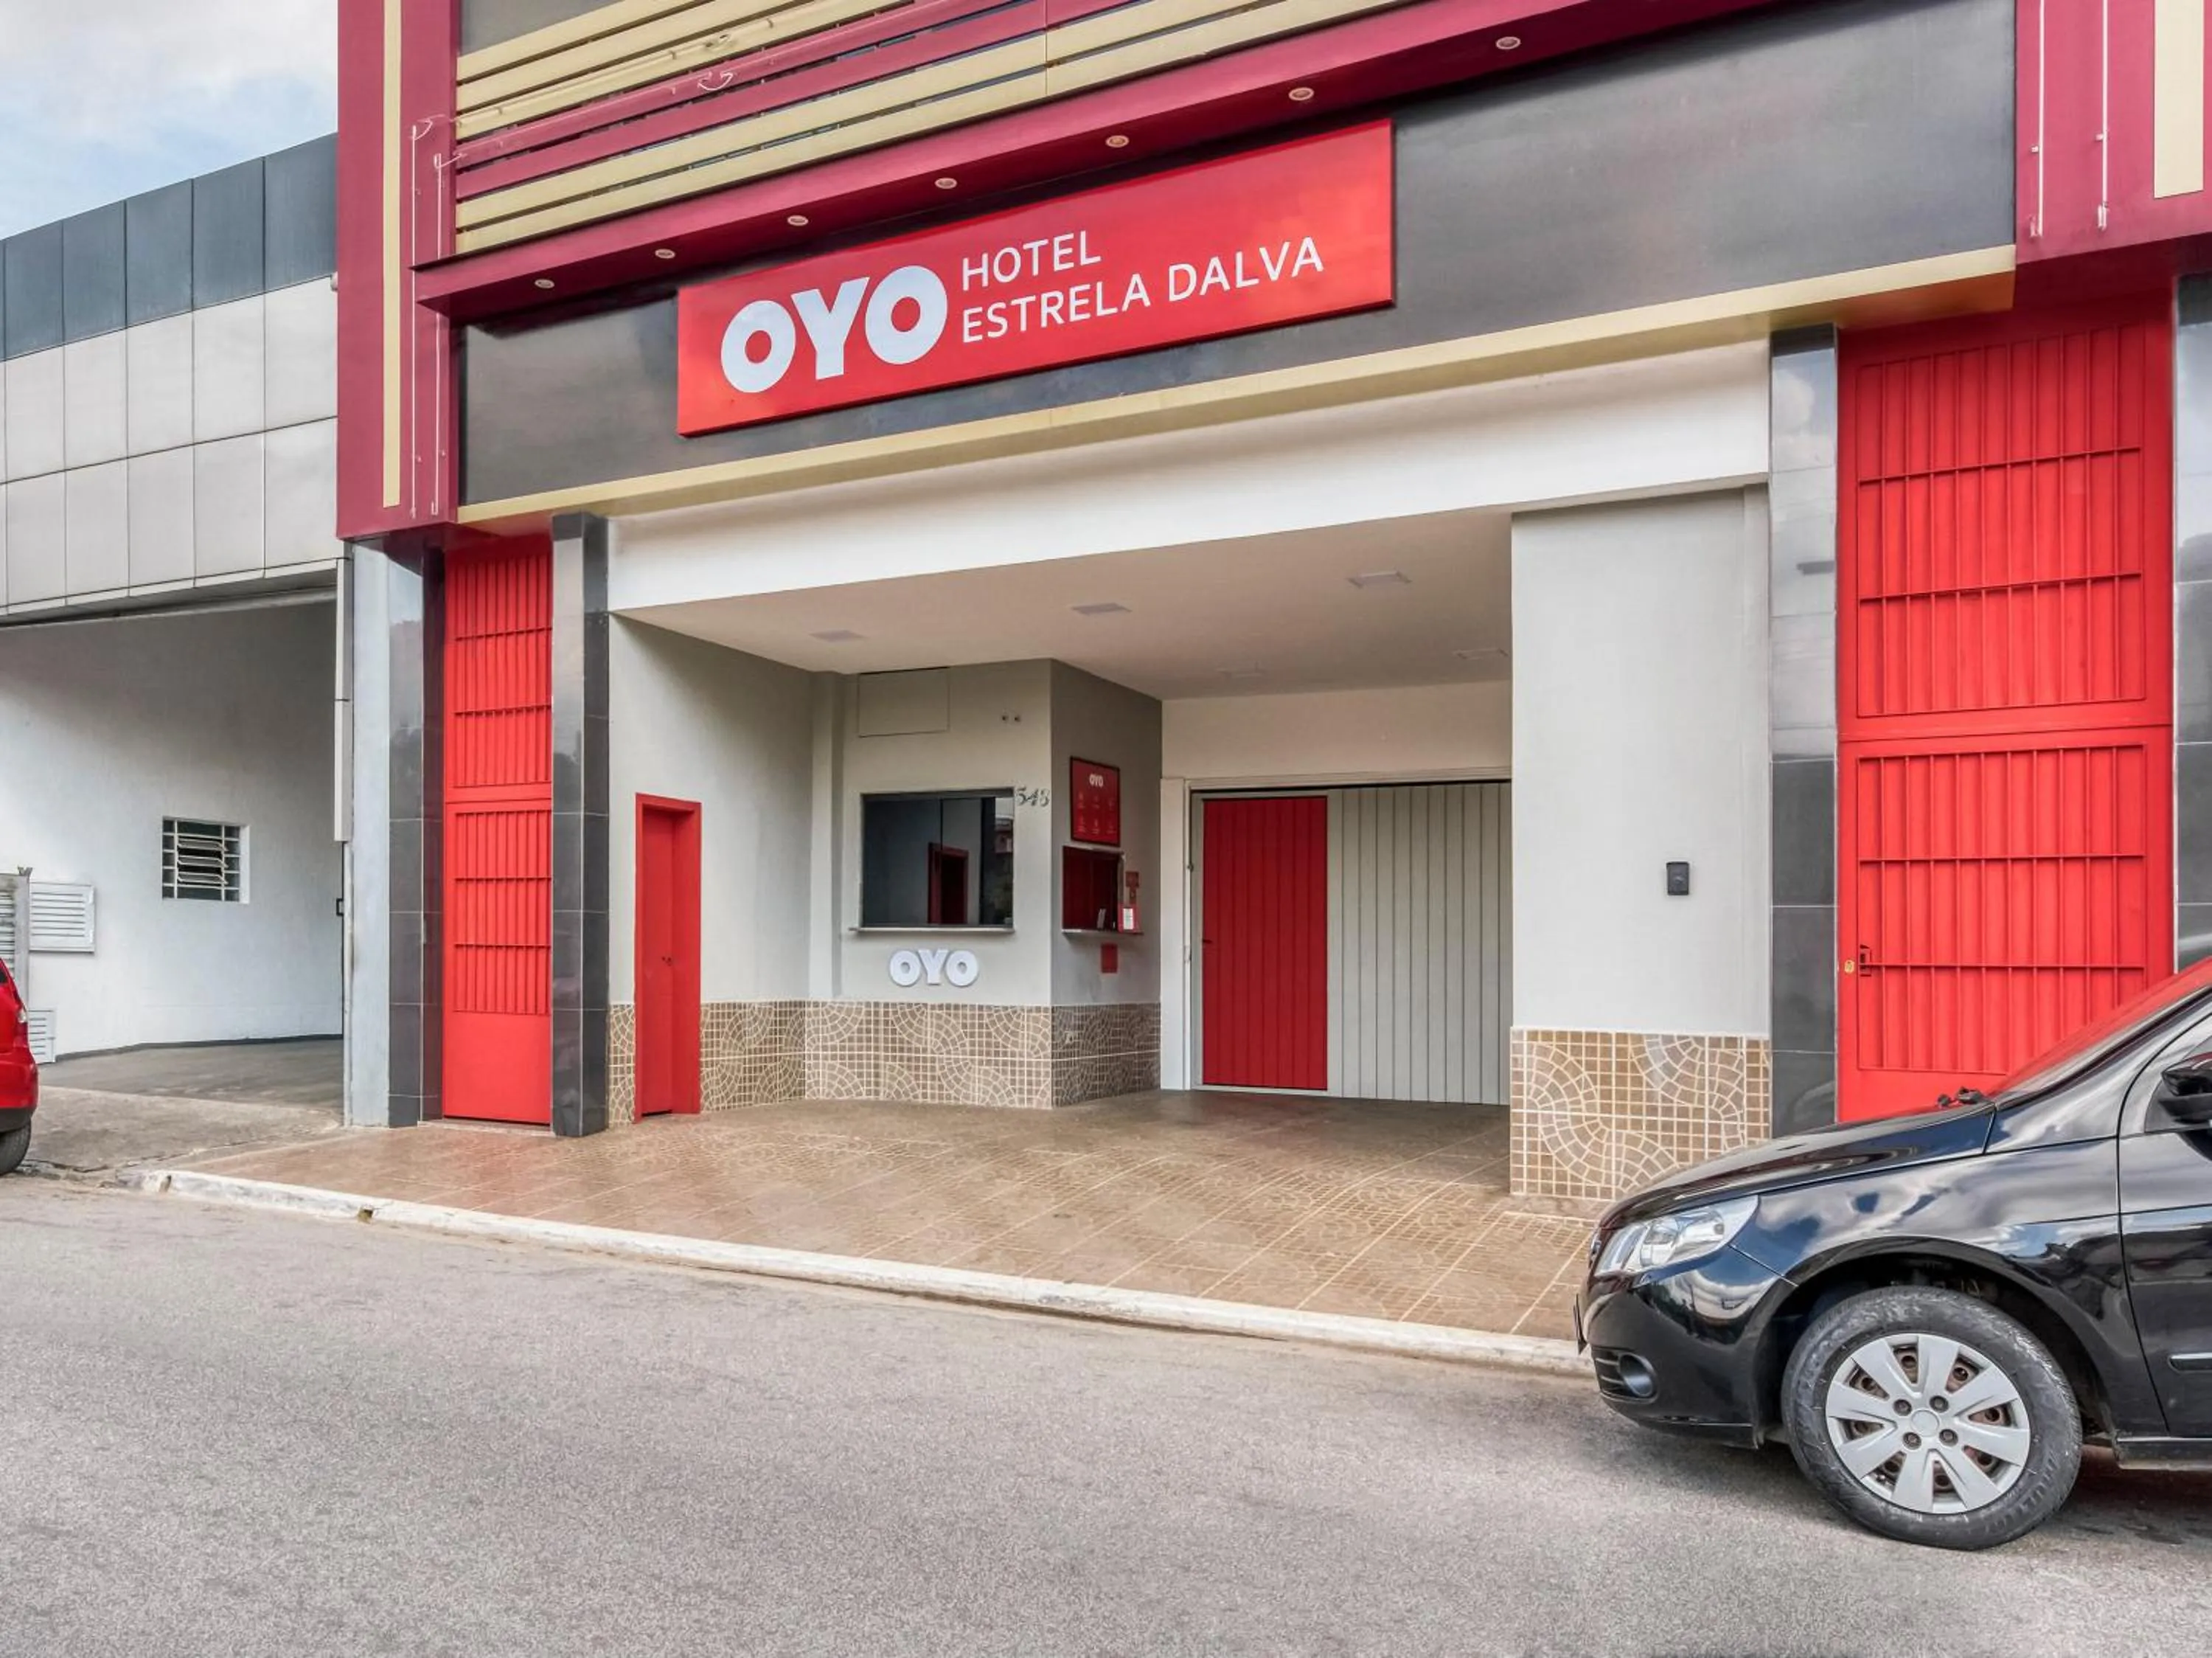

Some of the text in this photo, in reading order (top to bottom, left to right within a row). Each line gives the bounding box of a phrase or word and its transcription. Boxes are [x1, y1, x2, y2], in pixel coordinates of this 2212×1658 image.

[962, 231, 1101, 291] HOTEL
[963, 237, 1324, 343] ESTRELA DALVA
[720, 266, 947, 393] OYO
[1089, 773, 1105, 788] OYO
[889, 948, 979, 987] OYO
